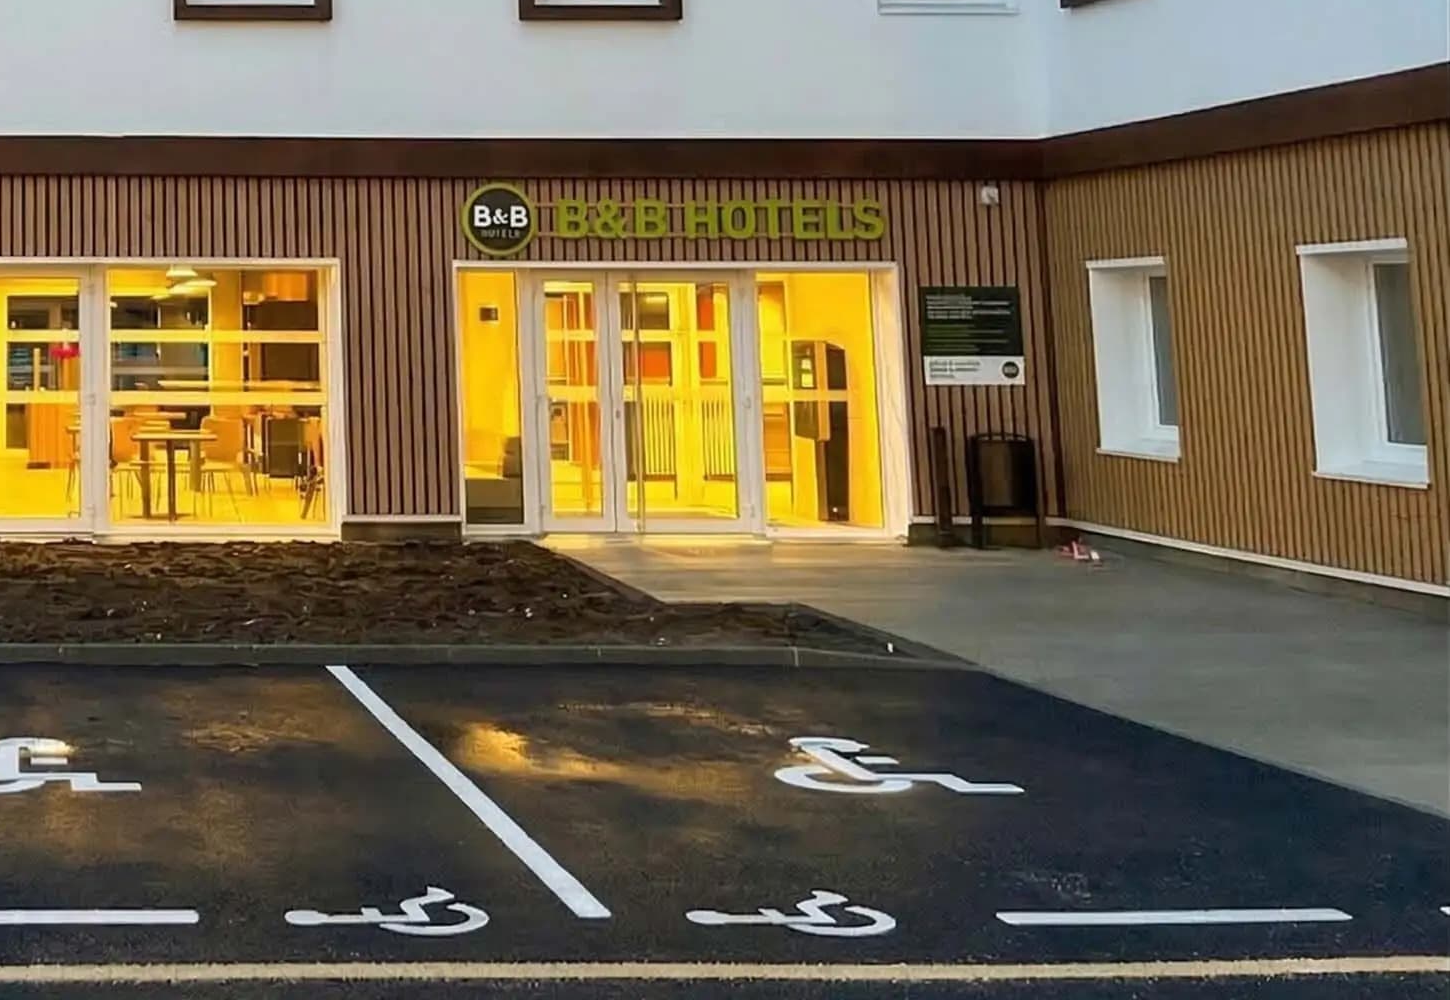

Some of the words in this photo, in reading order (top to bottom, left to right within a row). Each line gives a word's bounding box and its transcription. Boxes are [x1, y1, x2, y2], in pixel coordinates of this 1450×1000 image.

[473, 204, 529, 228] B&B
[557, 198, 668, 239] B&B
[684, 198, 885, 240] HOTELS
